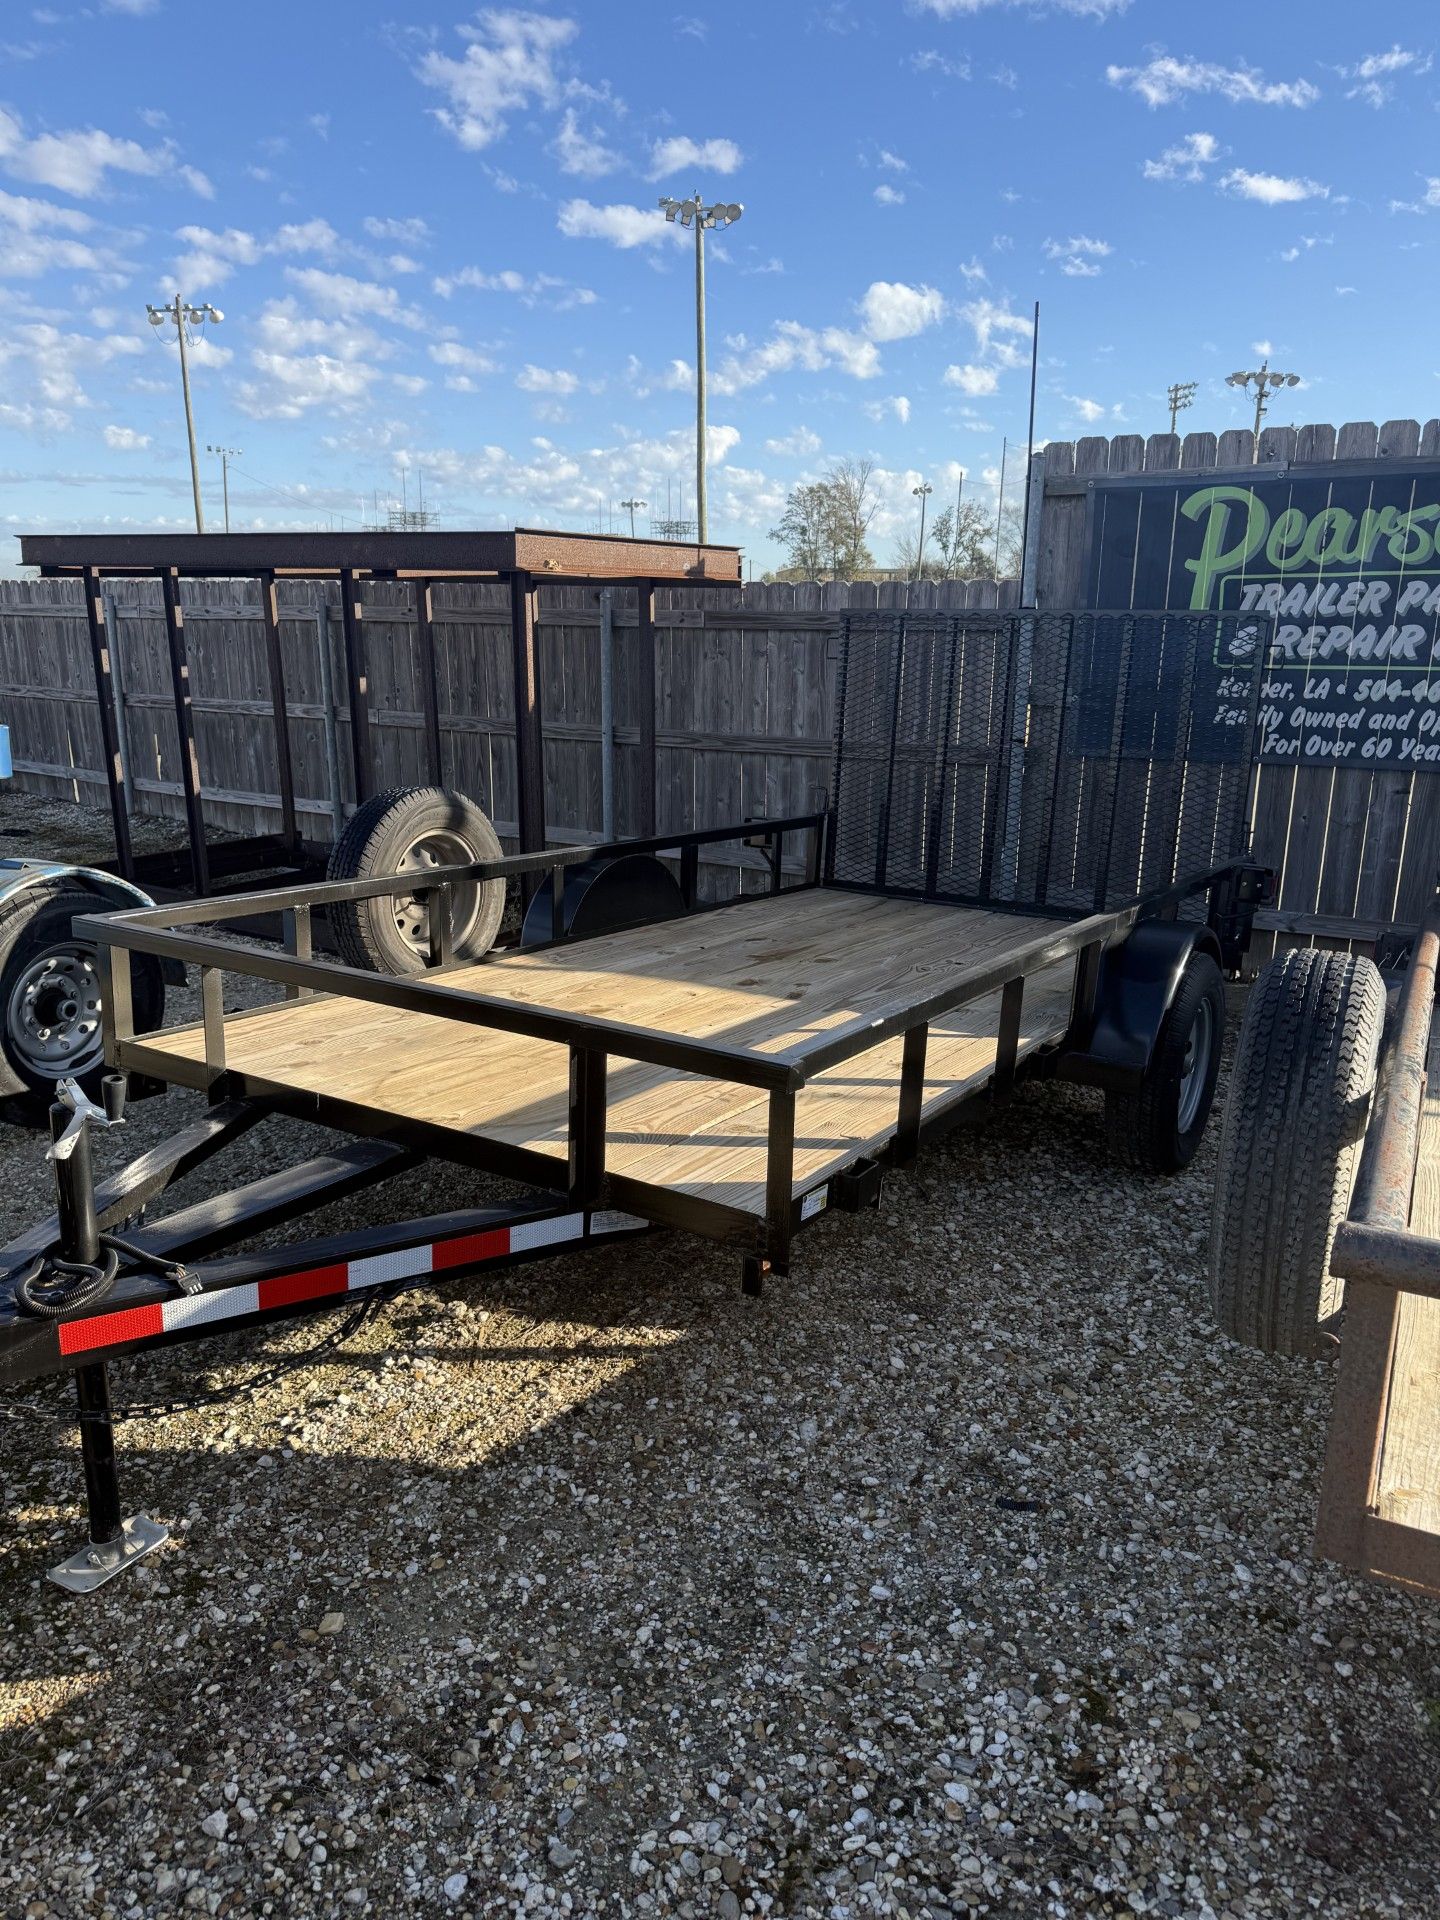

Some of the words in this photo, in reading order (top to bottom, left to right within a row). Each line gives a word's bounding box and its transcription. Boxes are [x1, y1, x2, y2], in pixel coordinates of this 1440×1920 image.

[1181, 487, 1440, 610] Pears
[1240, 581, 1392, 617] TRAILER
[1270, 624, 1427, 660] REPAIR
[1303, 677, 1331, 699] LA
[1290, 706, 1366, 730] Owned
[1368, 707, 1415, 731] and
[1263, 733, 1301, 755] For
[1305, 734, 1356, 757] Over
[1361, 736, 1393, 758] 60
[1398, 738, 1440, 761] Yea
